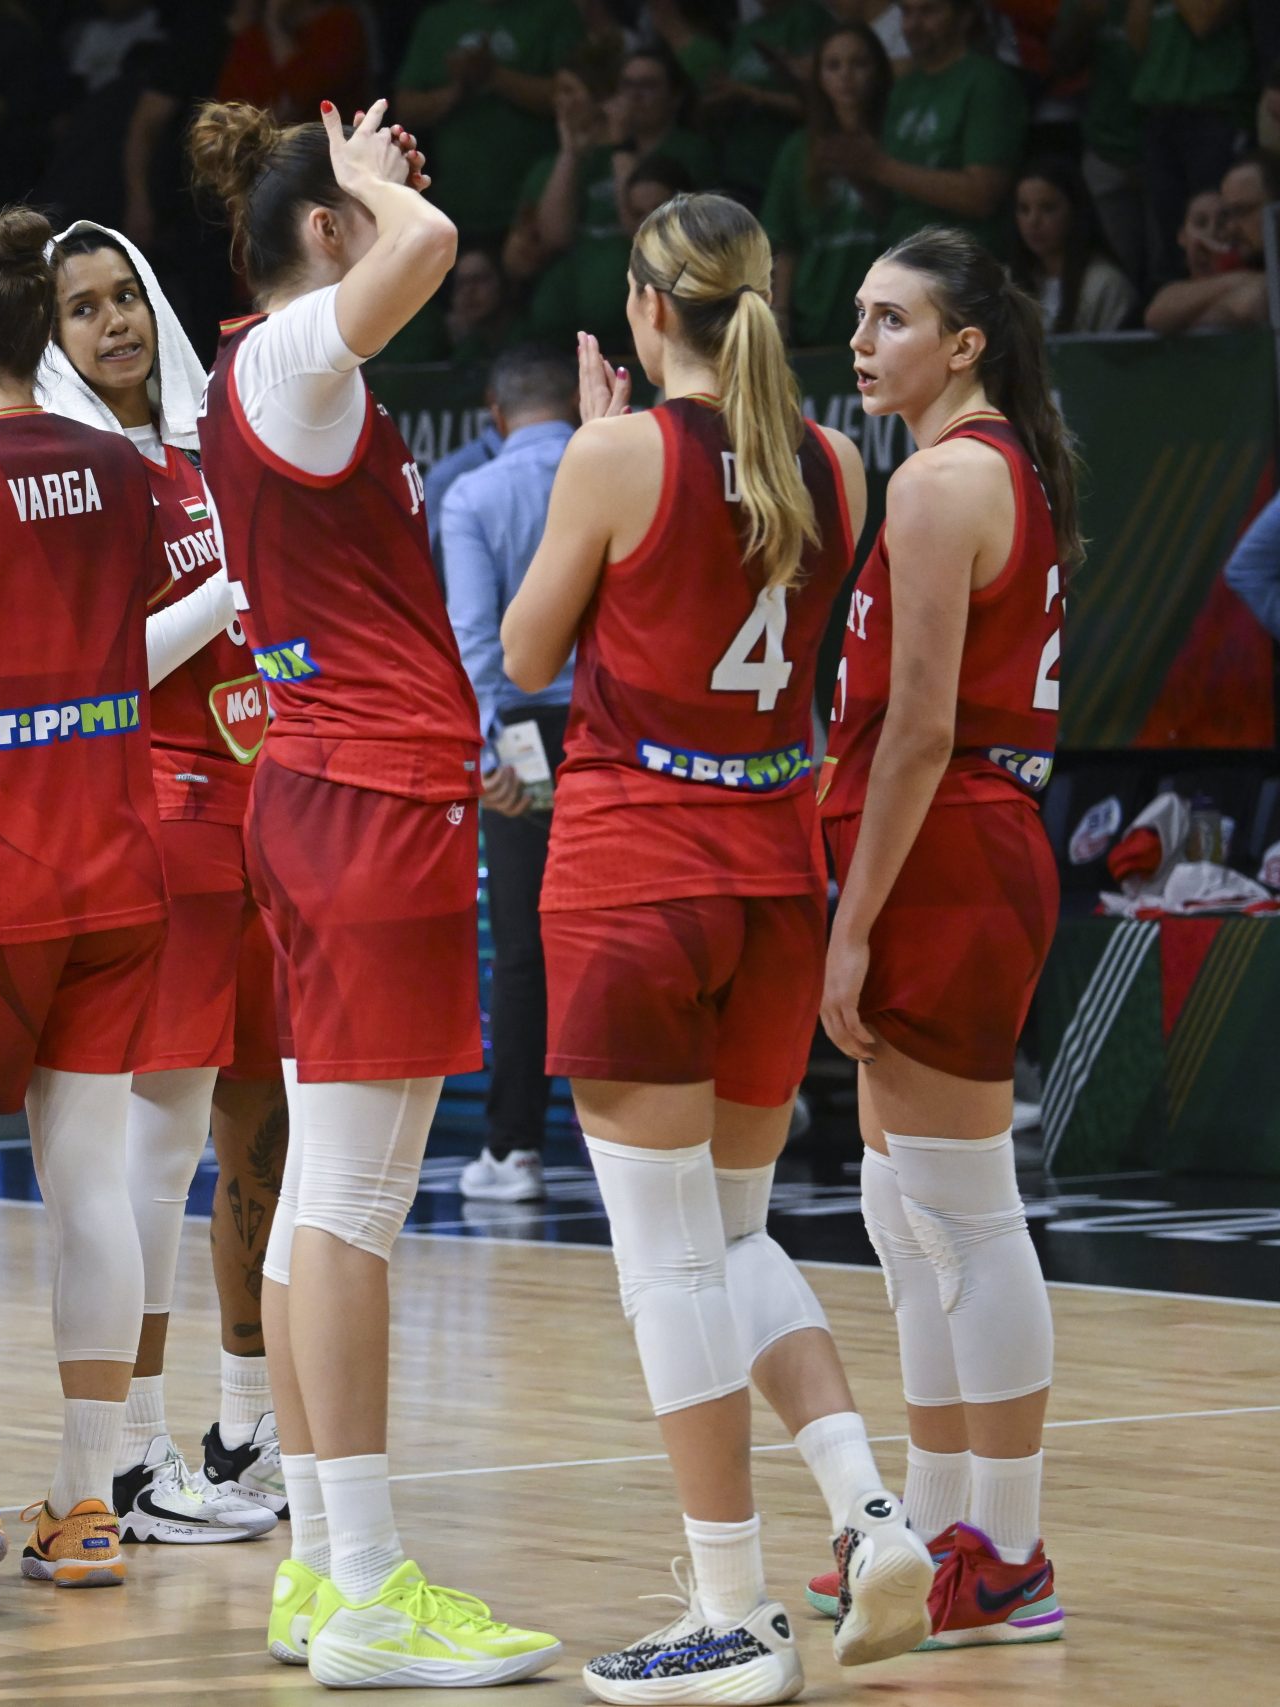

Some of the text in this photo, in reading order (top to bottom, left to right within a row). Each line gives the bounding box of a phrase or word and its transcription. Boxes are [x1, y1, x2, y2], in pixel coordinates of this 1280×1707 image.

[7, 468, 102, 522] VARGA
[711, 584, 793, 712] 4
[226, 686, 262, 724] MOL
